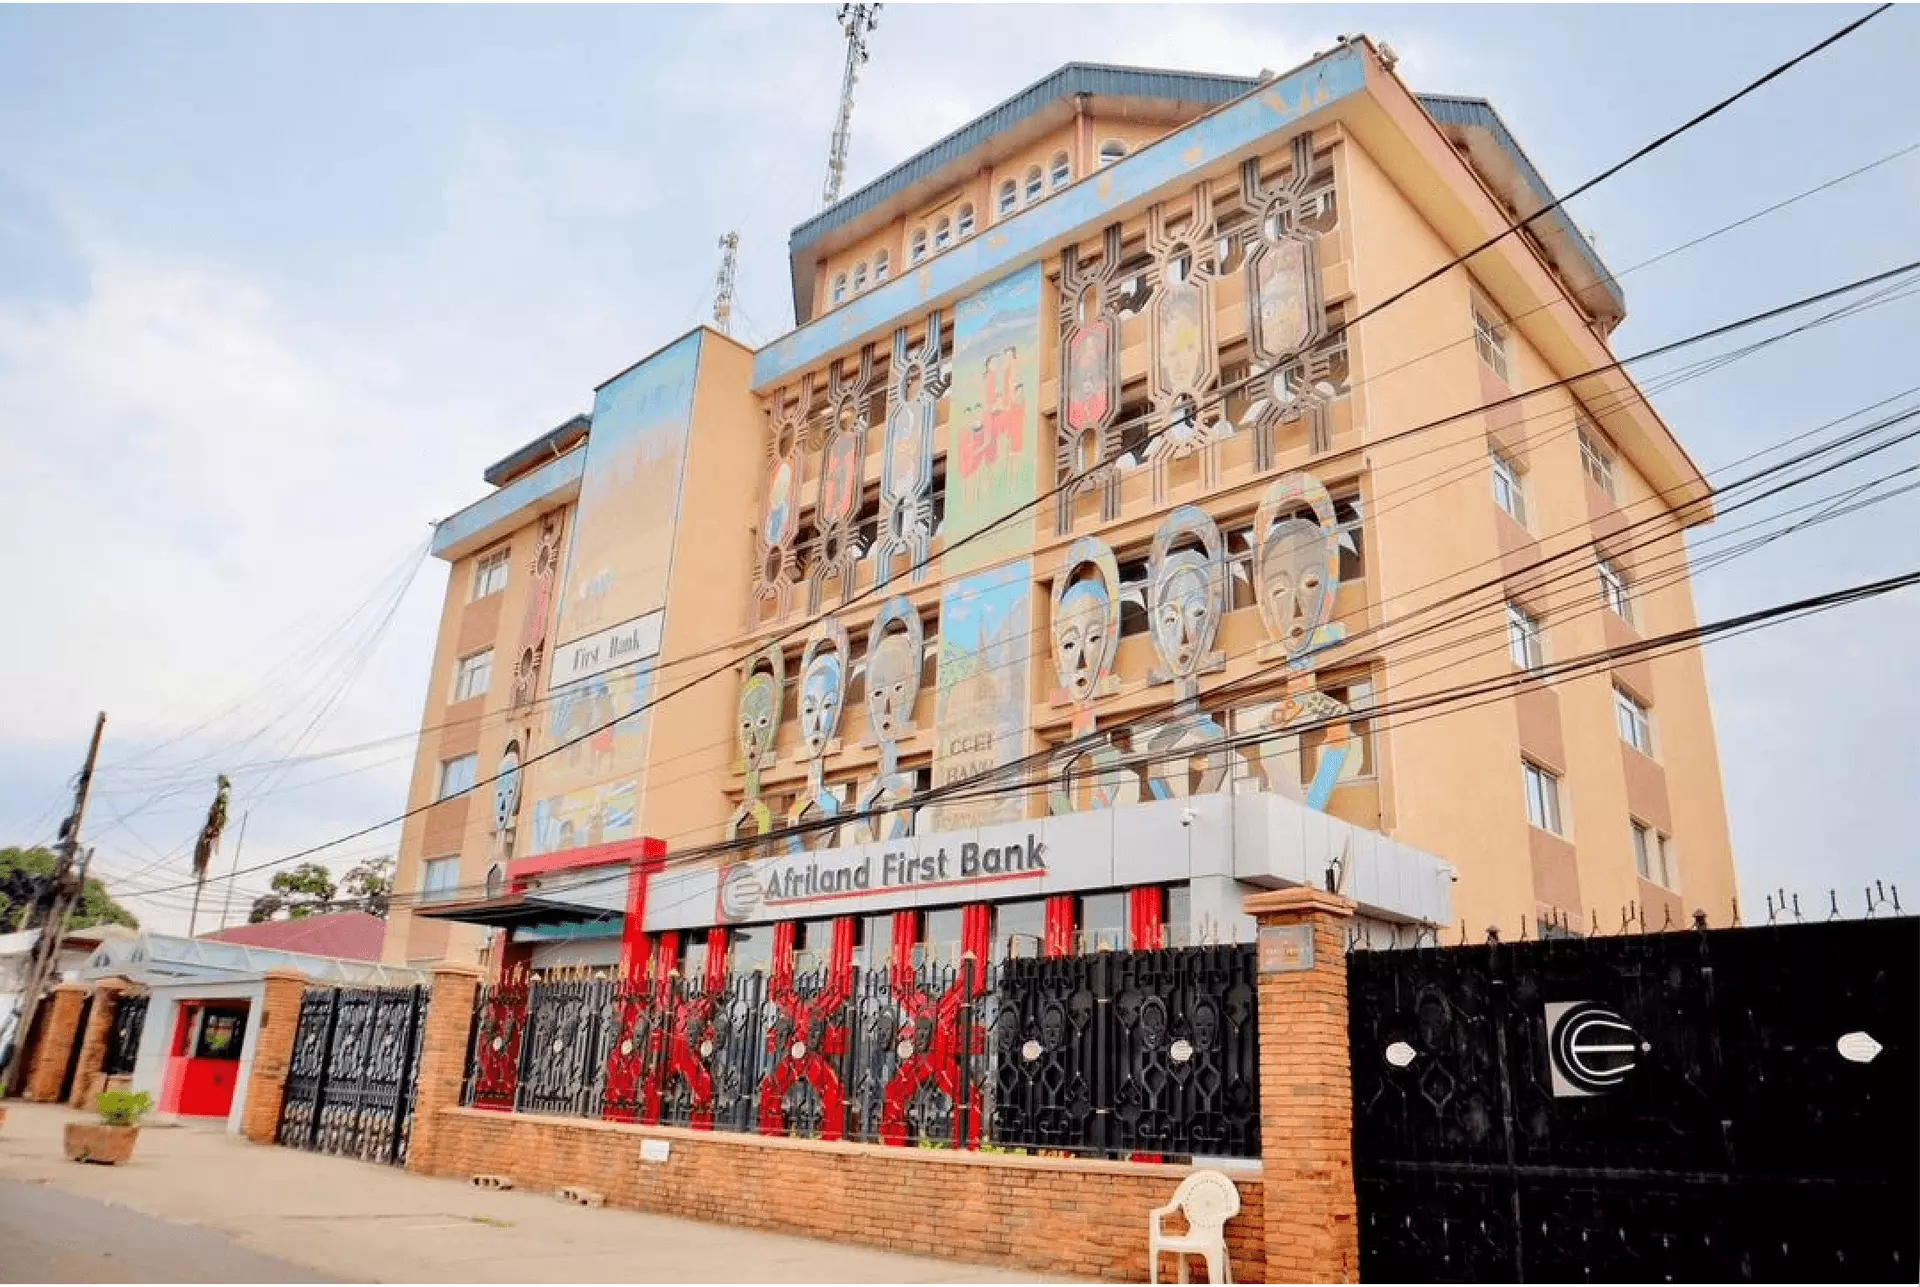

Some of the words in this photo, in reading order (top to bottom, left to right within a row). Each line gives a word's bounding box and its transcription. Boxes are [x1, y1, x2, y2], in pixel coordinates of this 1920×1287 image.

[572, 645, 600, 671] First
[766, 856, 871, 899] Afriland
[882, 847, 948, 886] First
[960, 833, 1046, 877] Bank
